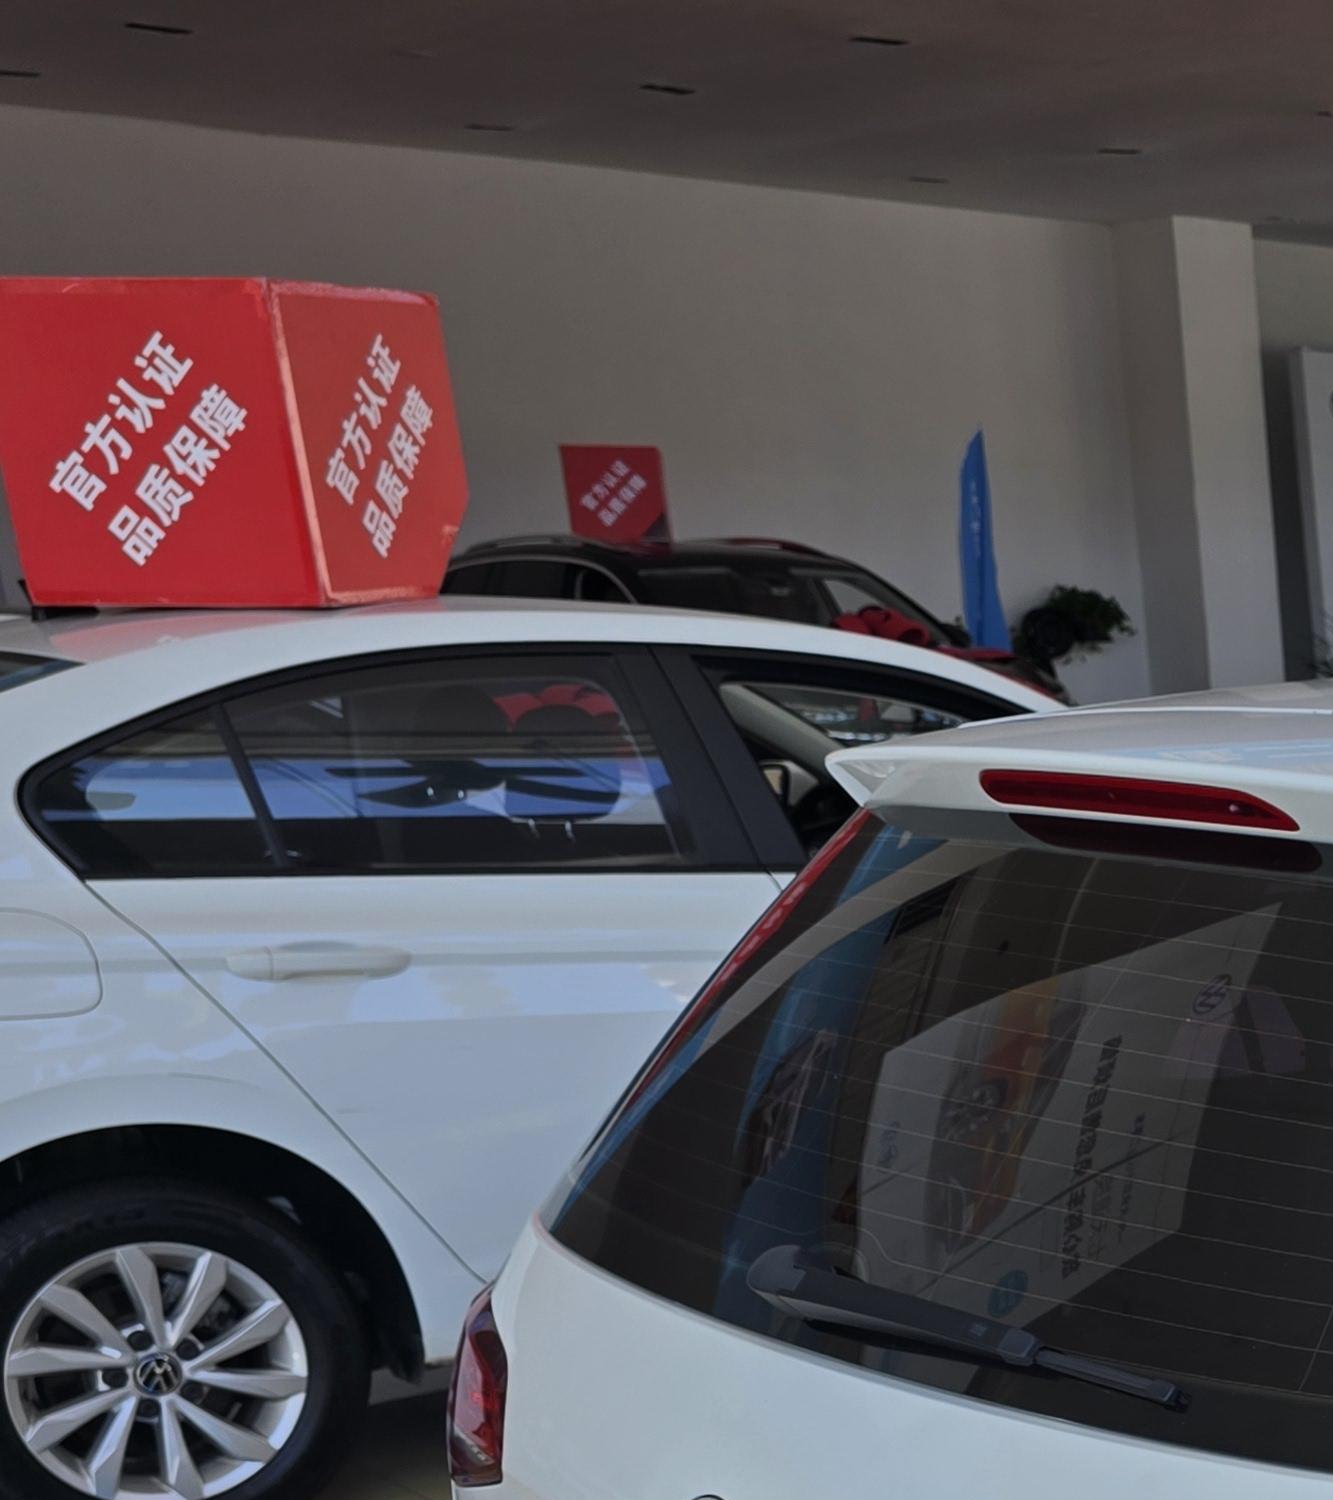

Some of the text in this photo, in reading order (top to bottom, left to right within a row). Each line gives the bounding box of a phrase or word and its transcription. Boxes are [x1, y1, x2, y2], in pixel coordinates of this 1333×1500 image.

[49, 330, 194, 511] 官方认证
[107, 383, 249, 566] 品质保障
[324, 333, 402, 506] 官方认证
[360, 384, 435, 559] 品质保障
